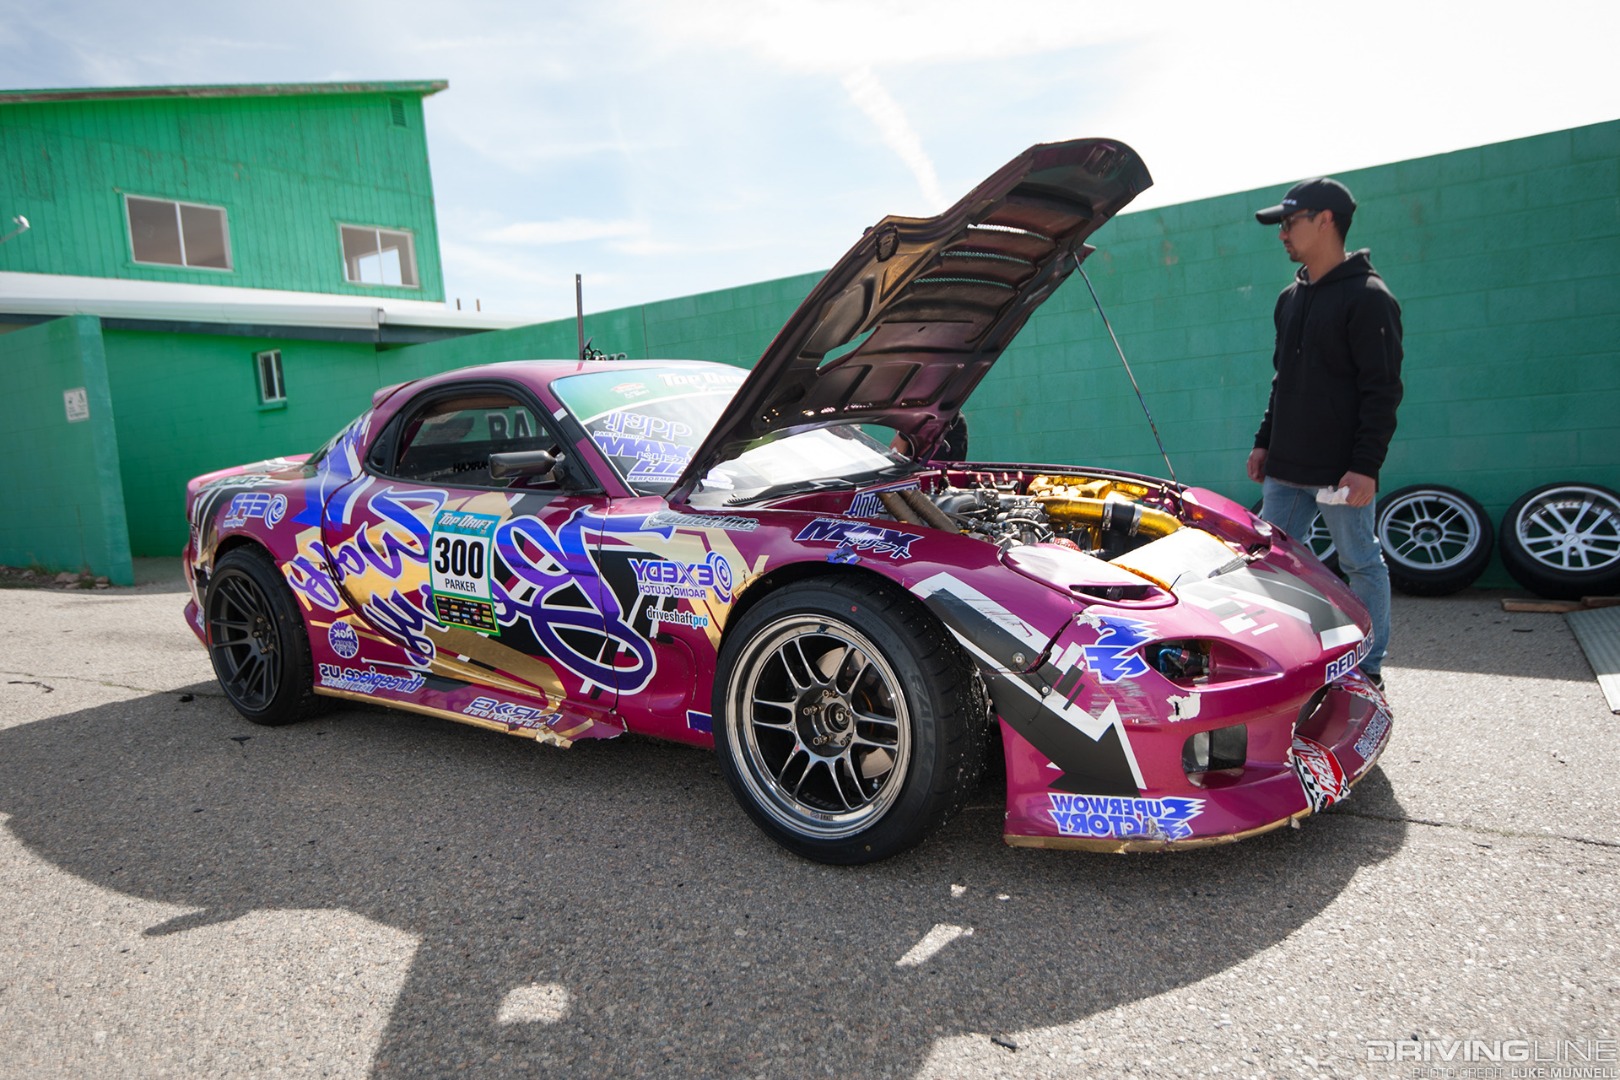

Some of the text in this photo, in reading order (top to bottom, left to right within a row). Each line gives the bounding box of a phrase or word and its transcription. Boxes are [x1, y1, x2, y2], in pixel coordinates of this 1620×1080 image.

[438, 512, 495, 533] TOP DRIFT
[794, 518, 925, 548] MAX
[434, 536, 485, 580] 300
[444, 577, 477, 593] PARKER
[646, 606, 708, 629] driveshaftpro
[1326, 651, 1356, 684] RED
